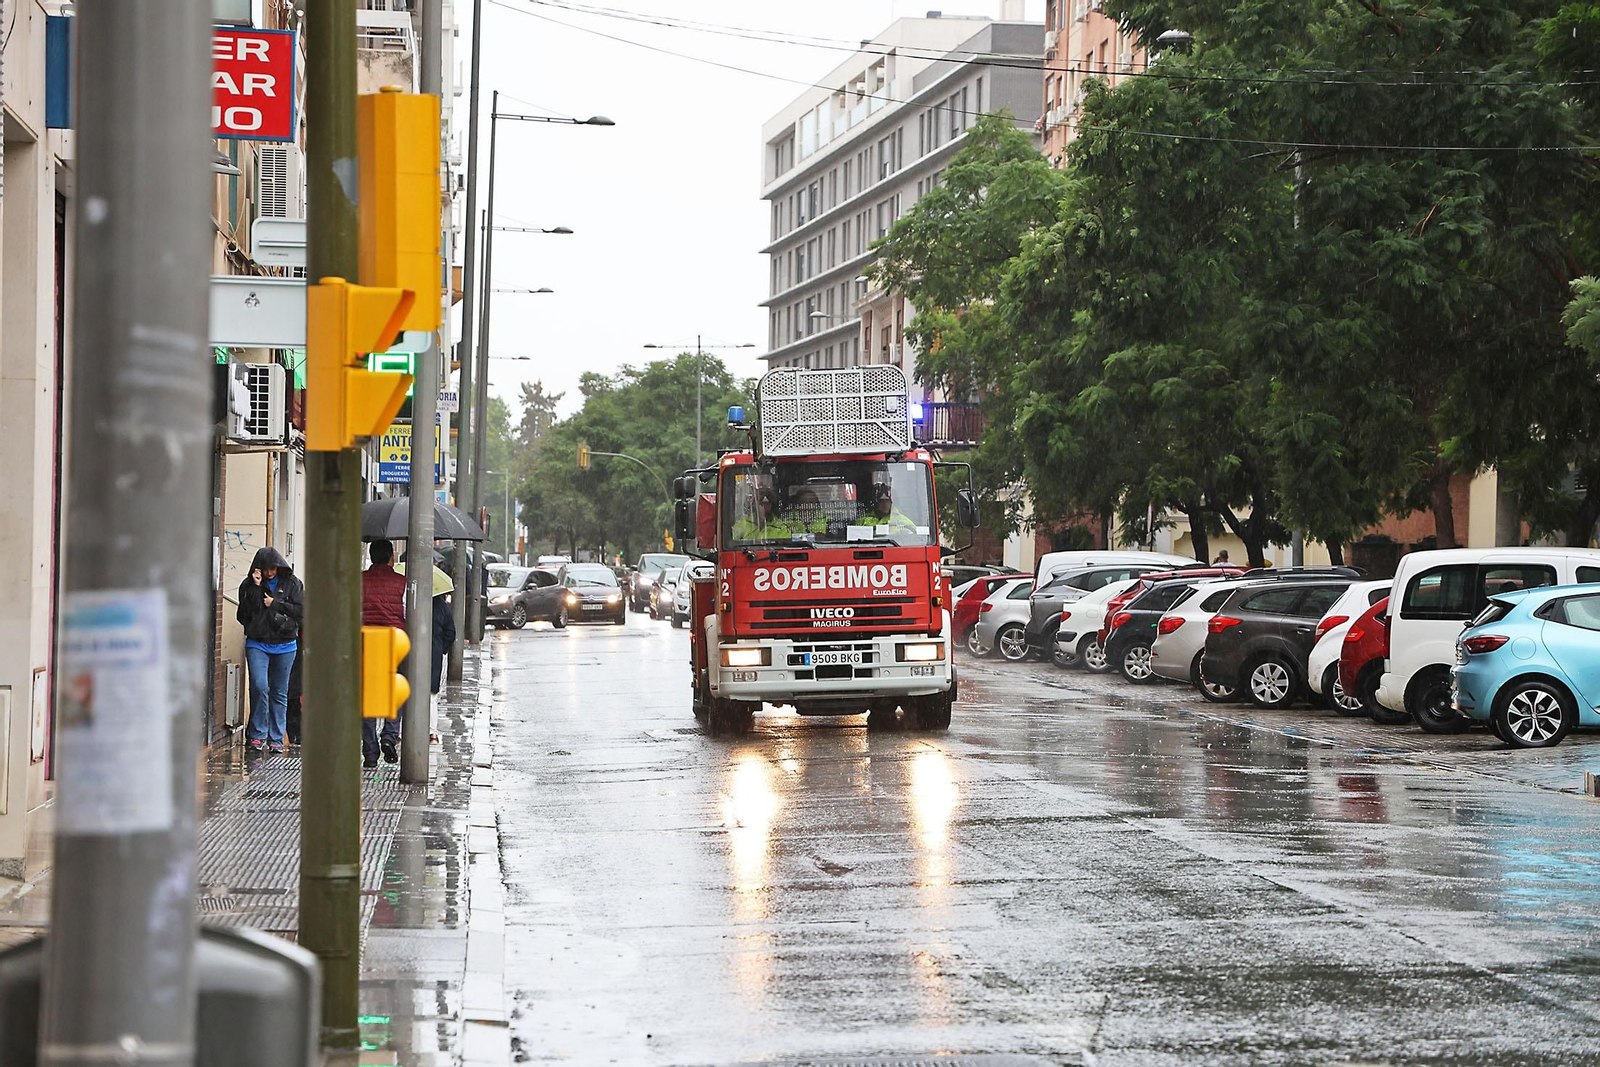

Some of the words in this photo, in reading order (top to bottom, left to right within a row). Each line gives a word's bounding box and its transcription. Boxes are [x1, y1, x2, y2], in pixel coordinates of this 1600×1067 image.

[383, 435, 411, 447] ANT
[934, 575, 941, 590] 2
[721, 582, 730, 596] 2
[810, 607, 855, 618] IVECO
[811, 653, 838, 664] 9509
[840, 653, 860, 663] BKG
